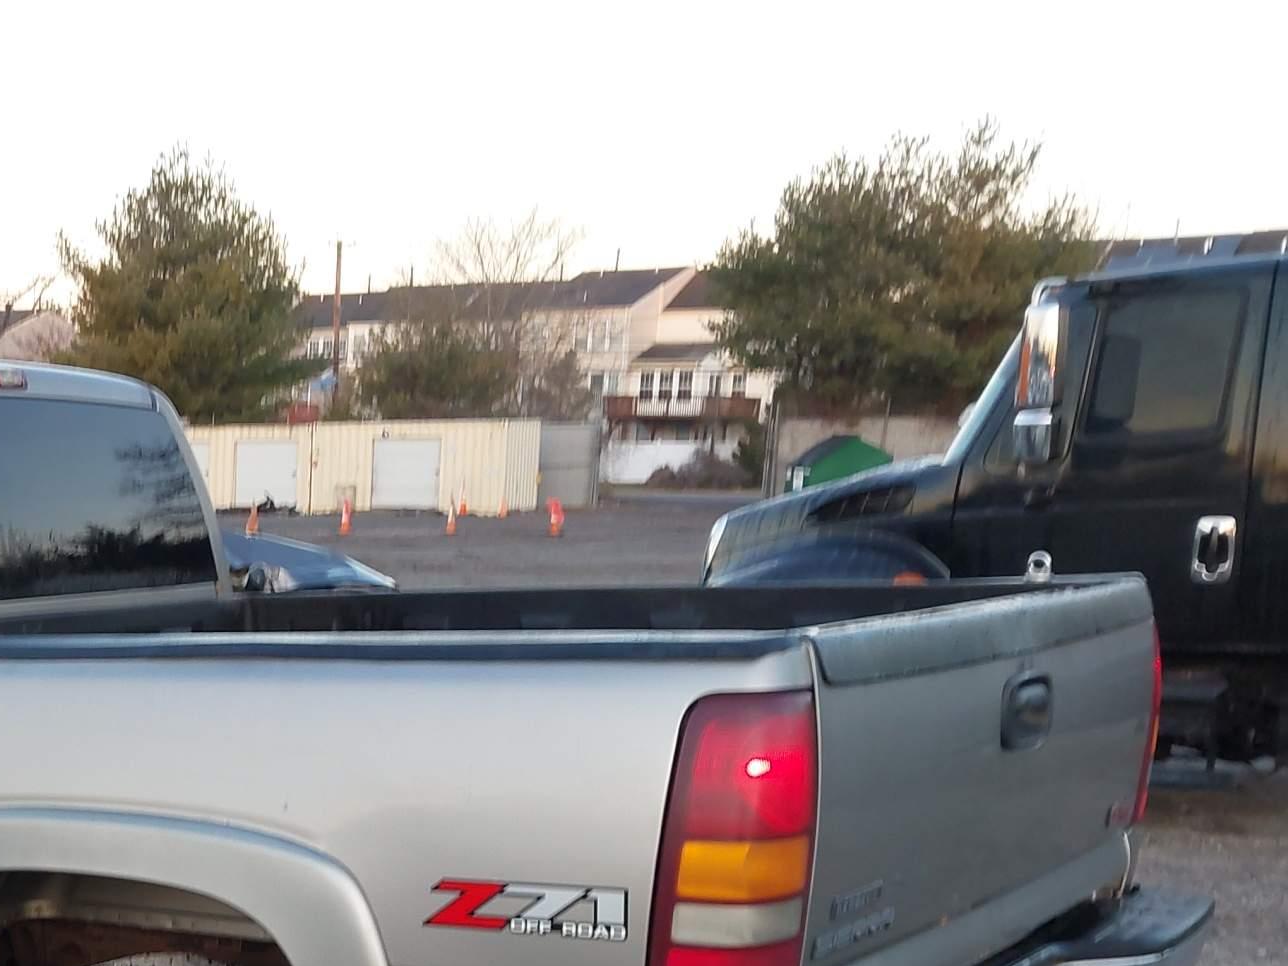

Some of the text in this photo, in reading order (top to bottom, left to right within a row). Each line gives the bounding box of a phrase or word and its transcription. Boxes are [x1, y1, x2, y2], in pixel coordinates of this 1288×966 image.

[423, 878, 628, 931] Z71
[510, 917, 627, 943] OFF ROAD
